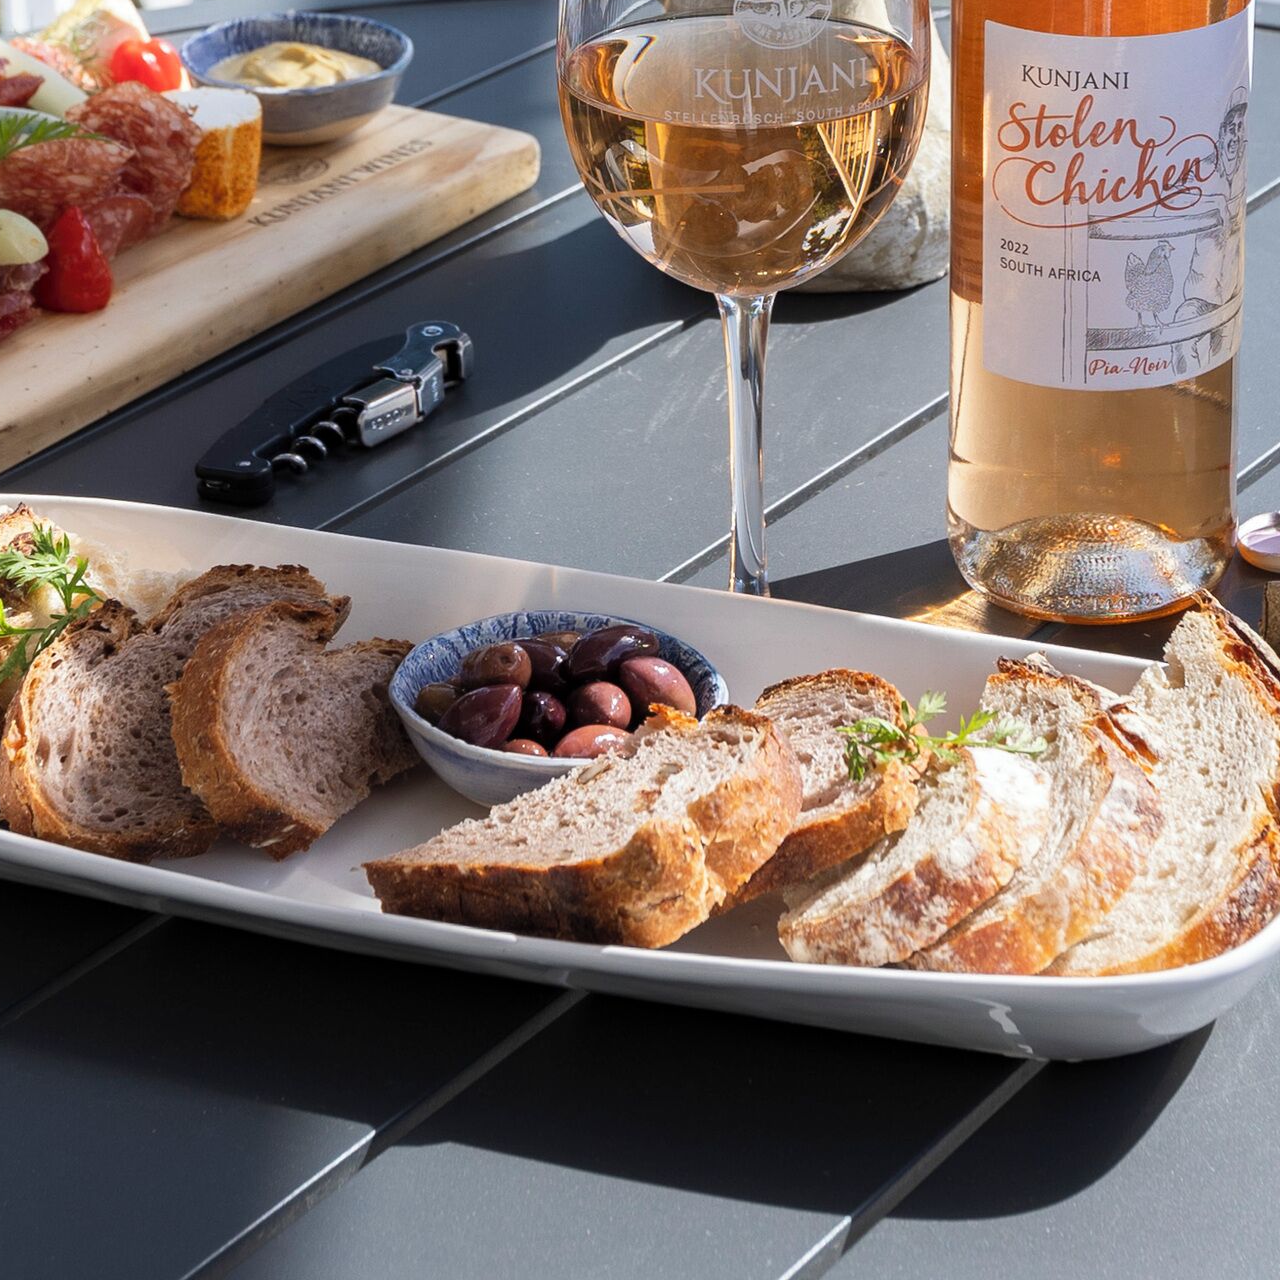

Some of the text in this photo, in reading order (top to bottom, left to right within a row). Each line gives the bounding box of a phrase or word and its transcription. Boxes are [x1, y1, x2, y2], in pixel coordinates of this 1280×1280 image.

[693, 57, 869, 105] KUNJANI
[1021, 64, 1130, 92] KUNJANI
[796, 106, 843, 122] SOUTH
[846, 95, 889, 115] AFRICA
[998, 95, 1176, 152] Stolen
[248, 140, 433, 227] KUNJANI WINES
[992, 135, 1218, 228] Chicken
[1000, 238, 1029, 256] 2022
[1000, 258, 1101, 283] SOUTH AFRICA
